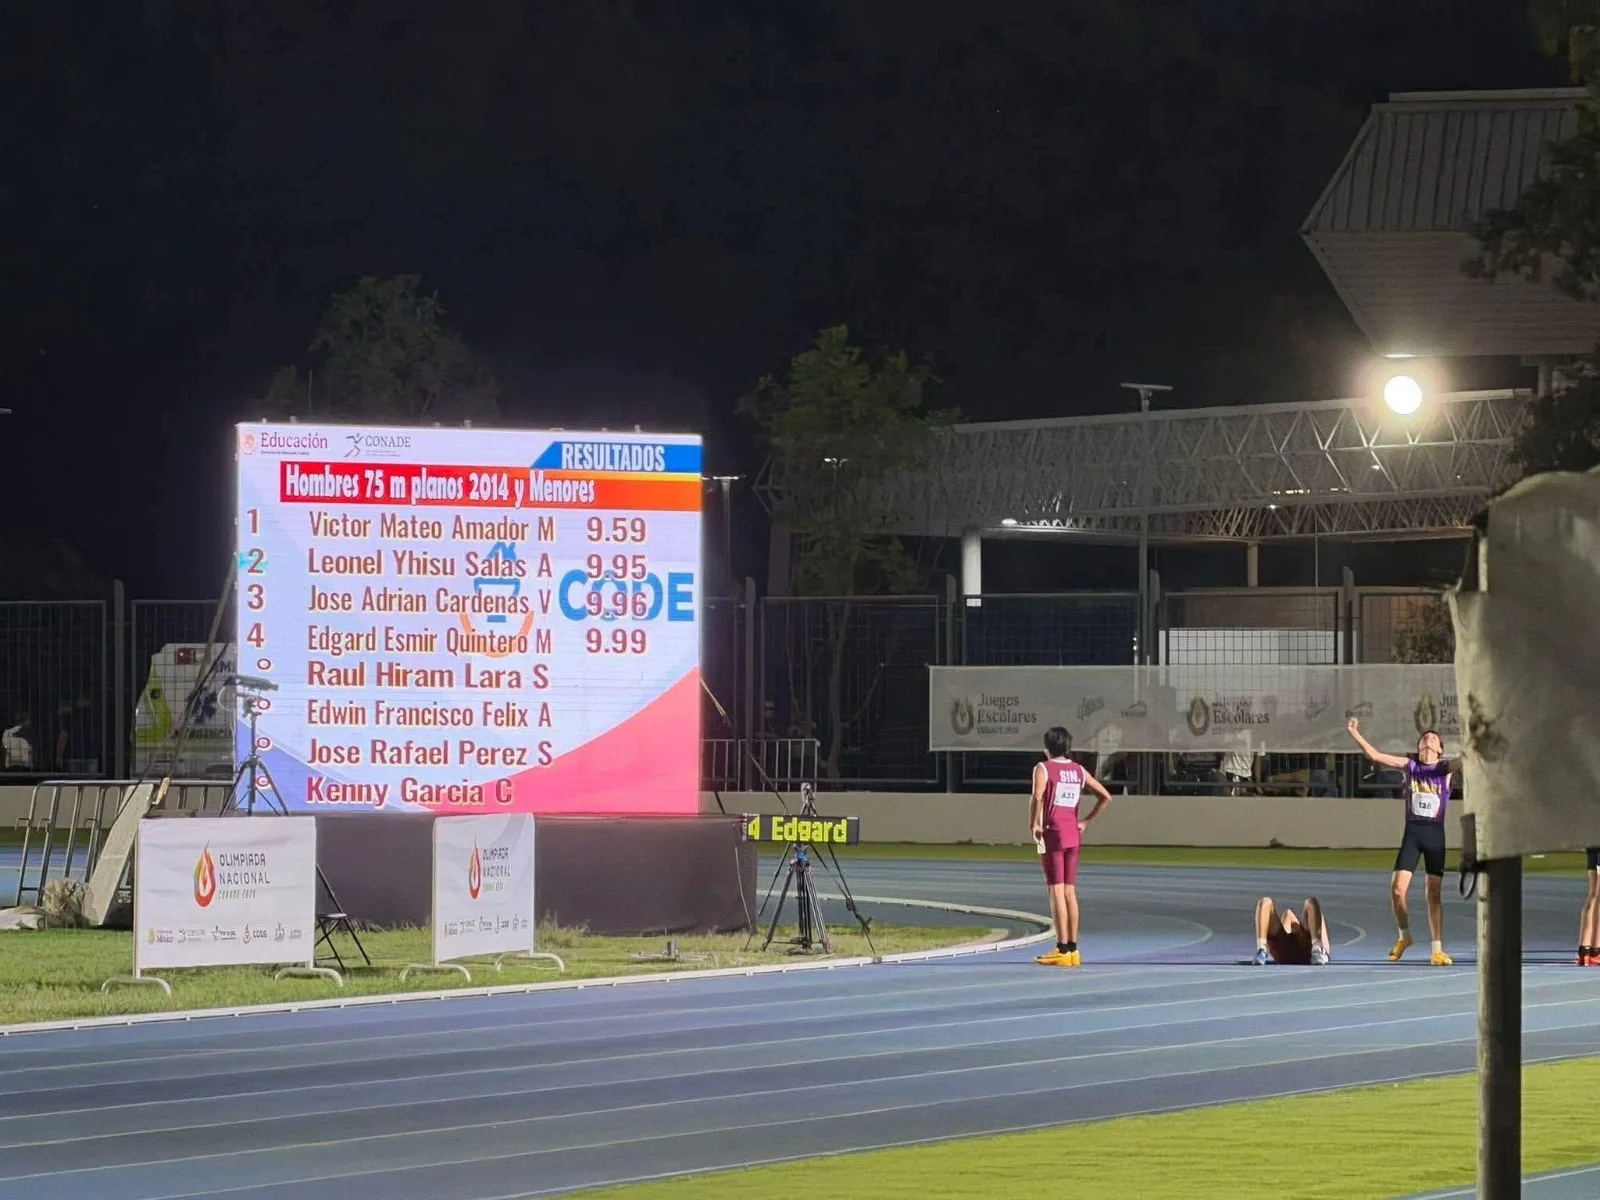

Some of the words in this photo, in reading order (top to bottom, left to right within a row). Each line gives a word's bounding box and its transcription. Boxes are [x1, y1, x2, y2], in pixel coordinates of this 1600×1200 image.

[261, 432, 328, 449] Educación
[365, 435, 411, 448] CONADE
[562, 443, 665, 472] RESULTADOS
[286, 463, 359, 497] Hombres
[365, 469, 384, 499] 75
[390, 474, 406, 499] m
[411, 467, 464, 506] planos
[469, 472, 509, 501] 2014
[514, 477, 525, 509] y
[529, 469, 595, 503] Menores
[247, 508, 258, 534] 1
[309, 511, 371, 538] Victor
[380, 513, 442, 539] Mateo
[452, 515, 529, 541] Amador
[538, 516, 554, 541] M
[586, 516, 647, 542] 9.59
[247, 548, 264, 574] 2
[308, 548, 382, 575] Leonel
[392, 550, 455, 576] Yhisu
[465, 551, 527, 578] Salas
[537, 552, 552, 578] A
[586, 553, 647, 579] 9.95
[247, 584, 264, 610] 3
[308, 585, 352, 612] Jose
[361, 586, 427, 613] Adrian
[436, 587, 529, 614] Cardenas
[538, 589, 551, 614] V
[586, 592, 647, 617] 9.96
[558, 569, 695, 622] CODE
[247, 622, 264, 648] 4
[308, 624, 376, 656] Edgard
[384, 626, 438, 652] Esmir
[446, 627, 528, 656] Quintero
[536, 628, 552, 654] M
[586, 628, 647, 653] 9.99
[308, 660, 365, 687] Raul
[376, 661, 454, 688] Hiram
[464, 662, 522, 689] Lara
[532, 663, 549, 689] S
[308, 699, 366, 725] Edwin
[375, 699, 474, 726] Francisco
[482, 701, 529, 727] Felix
[538, 702, 552, 727] A
[977, 693, 1019, 712] Juegos
[977, 709, 1037, 724] Escolares
[307, 738, 360, 764] Jose
[370, 738, 449, 765] Rafael
[458, 740, 528, 765] Perez
[538, 741, 553, 766] S
[306, 776, 389, 806] Kenny
[400, 777, 484, 803] Garcia
[495, 778, 512, 803] C
[748, 816, 760, 840] 4
[772, 816, 847, 843] Edgard
[219, 853, 266, 867] OLIMPIADA
[219, 872, 270, 885] NACIONAL
